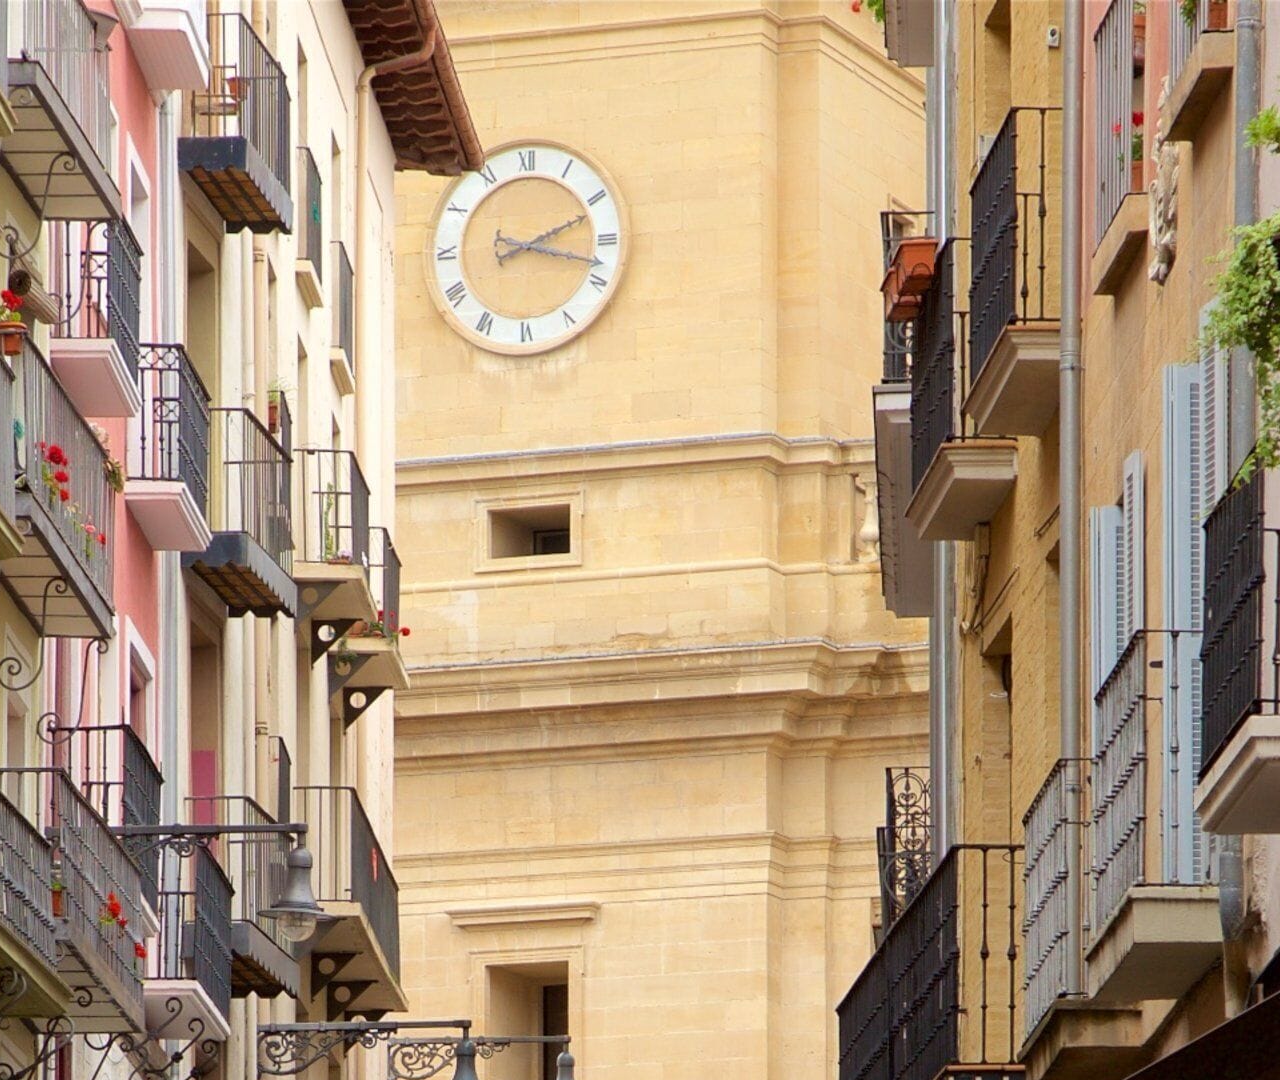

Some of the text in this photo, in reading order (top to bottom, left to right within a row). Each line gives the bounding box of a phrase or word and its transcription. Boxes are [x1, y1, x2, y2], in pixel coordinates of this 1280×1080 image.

[518, 150, 536, 172] XII
[561, 159, 574, 178] I
[480, 164, 498, 187] XI
[587, 189, 606, 207] II
[447, 201, 468, 218] X
[598, 233, 618, 246] III
[437, 245, 457, 261] IX
[445, 281, 468, 308] VIII
[475, 311, 494, 336] VII
[562, 310, 577, 328] V
[520, 321, 534, 342] VI
